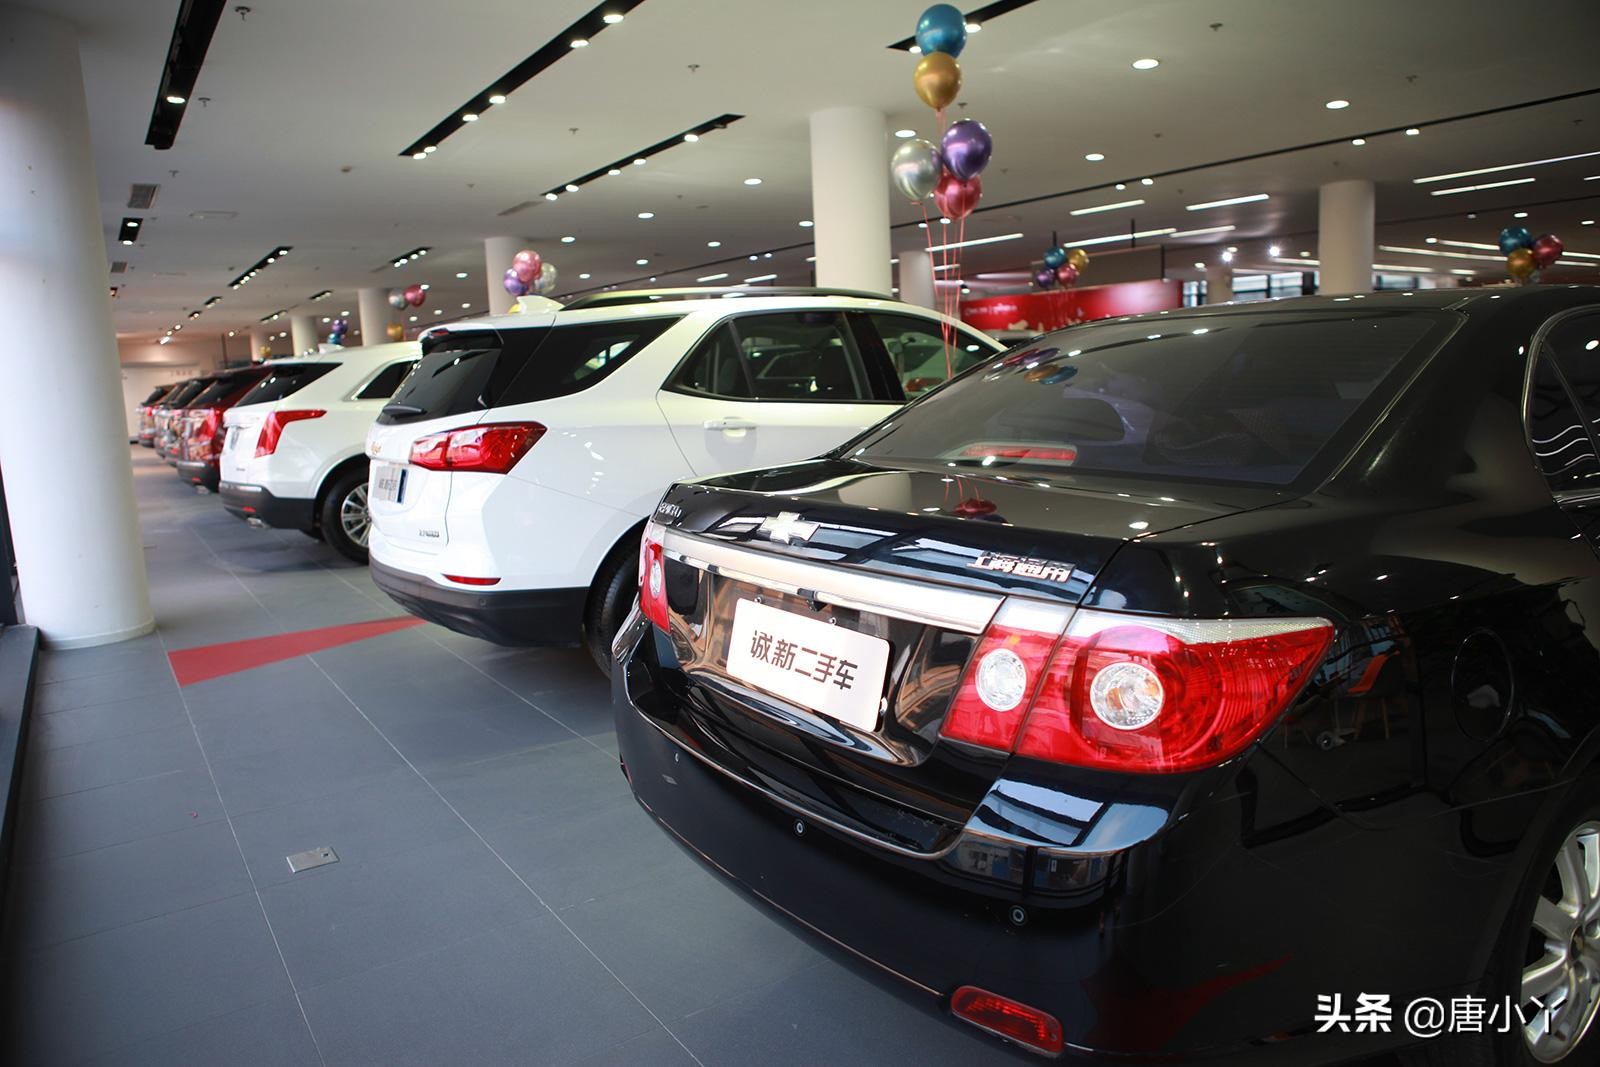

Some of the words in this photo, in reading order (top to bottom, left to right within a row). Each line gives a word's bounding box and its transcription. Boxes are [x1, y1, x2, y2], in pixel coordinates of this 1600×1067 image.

[750, 630, 858, 690] 诚新二手车
